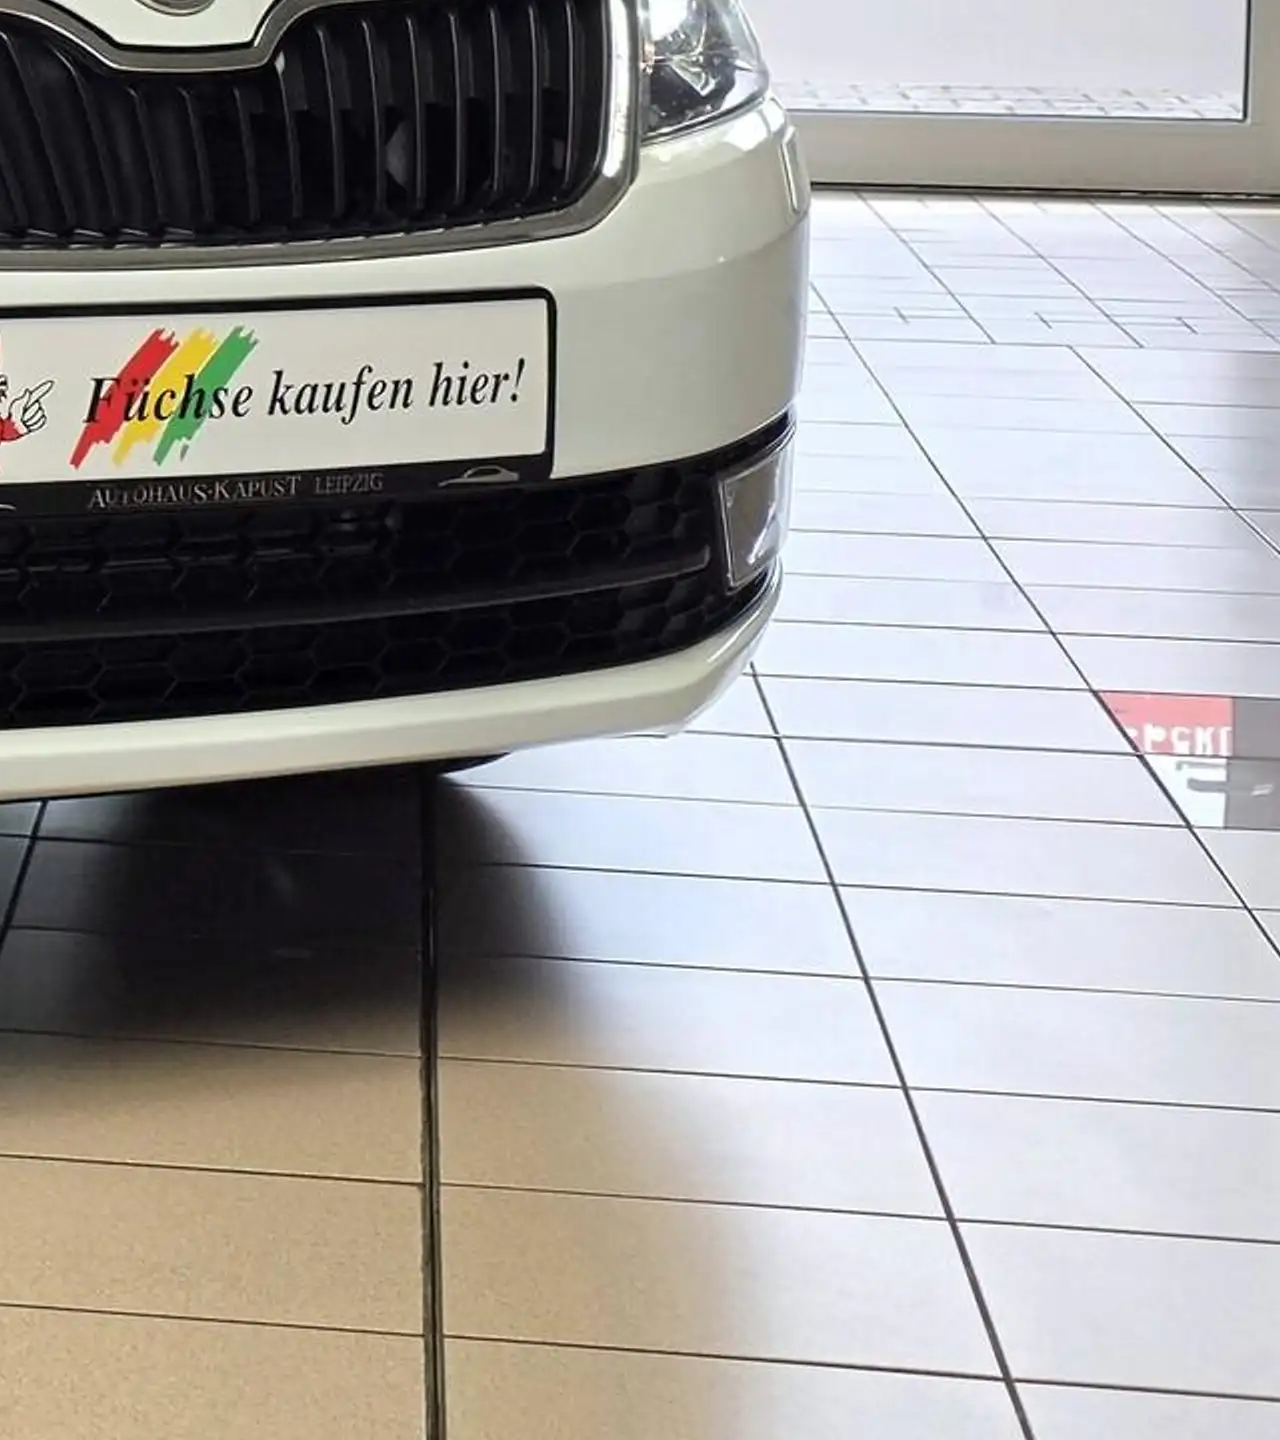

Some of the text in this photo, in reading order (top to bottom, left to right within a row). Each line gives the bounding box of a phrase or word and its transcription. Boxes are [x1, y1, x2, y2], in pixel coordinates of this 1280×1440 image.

[82, 357, 526, 425] Füchse kaufen hier!
[314, 471, 385, 495] LEIPZIG
